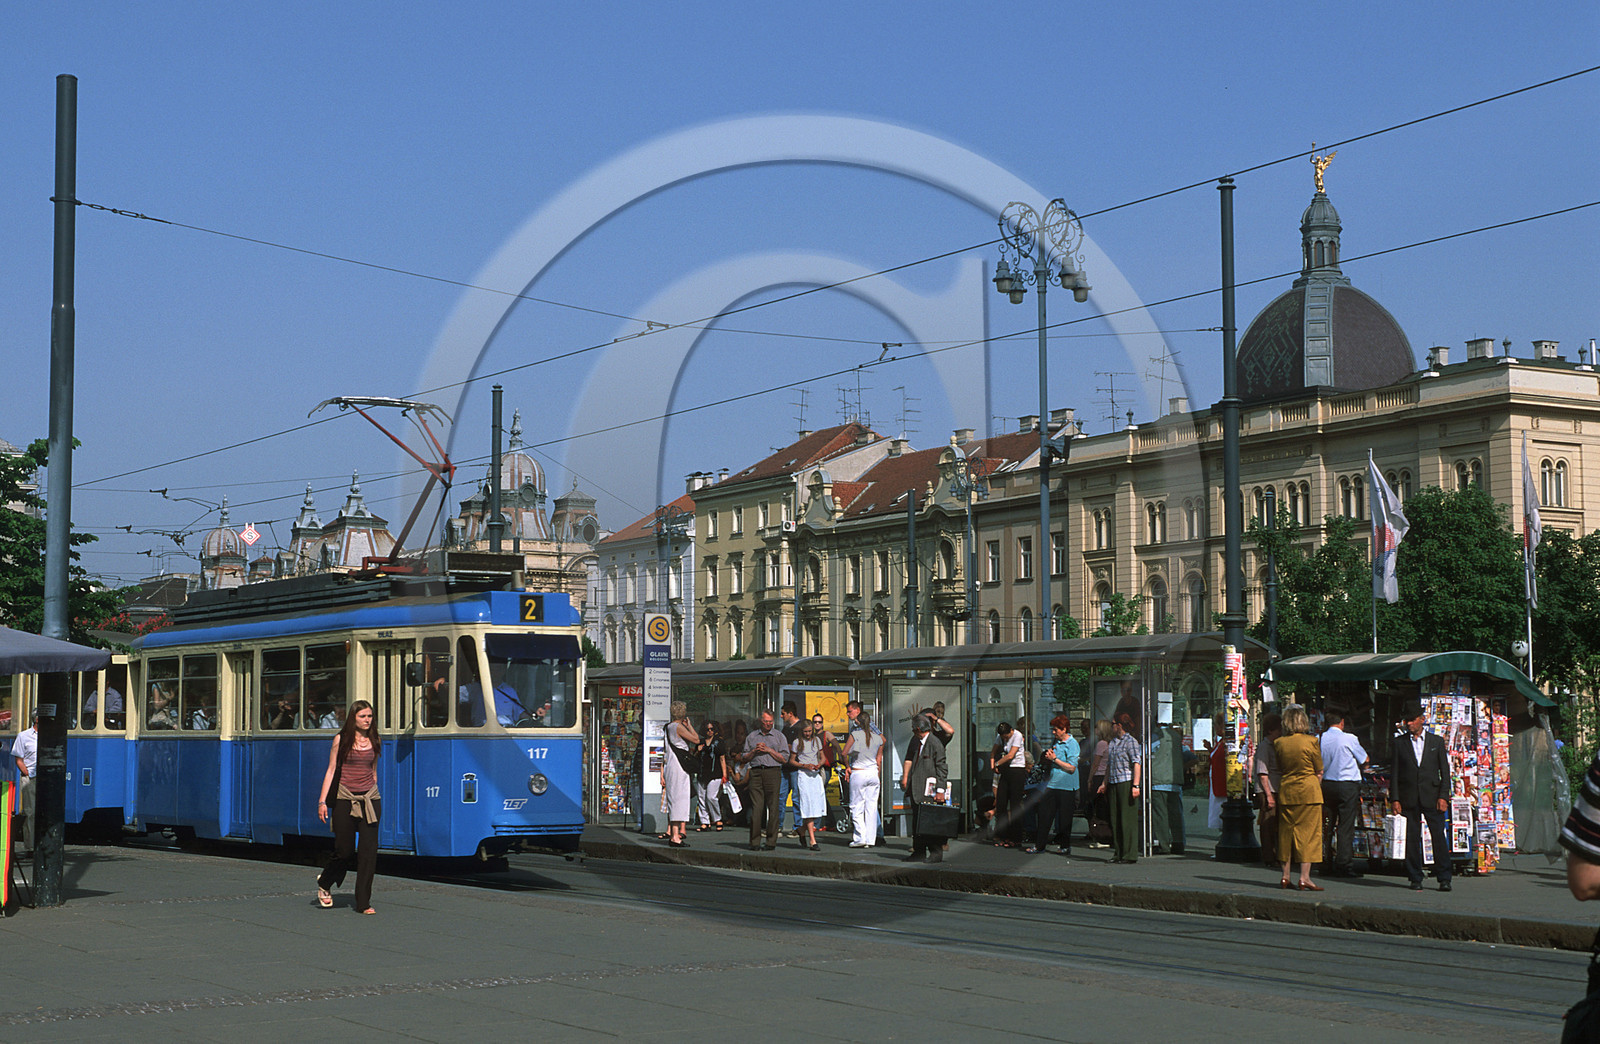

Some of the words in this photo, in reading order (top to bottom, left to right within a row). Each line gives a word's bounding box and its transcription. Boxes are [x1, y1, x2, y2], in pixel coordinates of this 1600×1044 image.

[247, 531, 254, 540] S
[524, 598, 536, 620] 2
[654, 621, 665, 637] S
[527, 747, 548, 759] 117
[425, 786, 440, 798] 117
[503, 798, 528, 810] ZET
